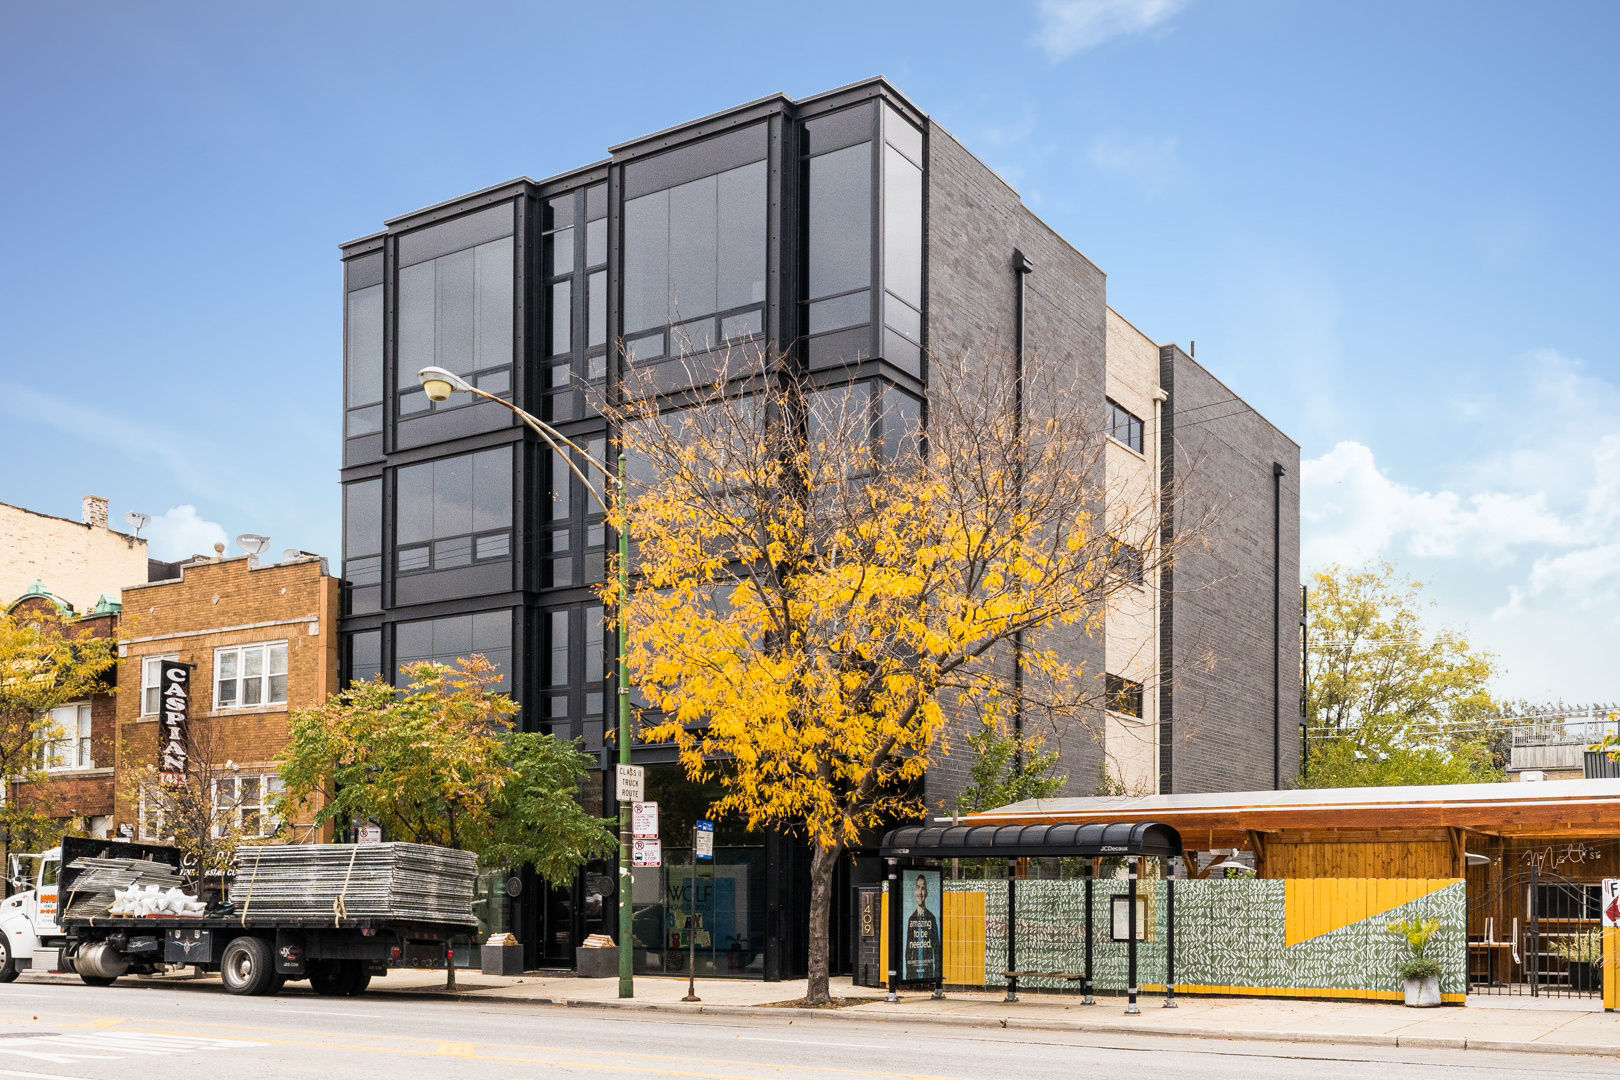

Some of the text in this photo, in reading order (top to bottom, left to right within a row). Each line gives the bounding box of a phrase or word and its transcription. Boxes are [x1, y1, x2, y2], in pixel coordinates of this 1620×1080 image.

[163, 668, 187, 771] CASPIAN
[619, 767, 636, 777] CLASS
[622, 778, 639, 787] TRUCK
[621, 789, 639, 798] ROUTE
[863, 894, 872, 934] 1409
[909, 920, 932, 930] amazing
[913, 929, 928, 938] to be
[909, 939, 932, 949] needed.
